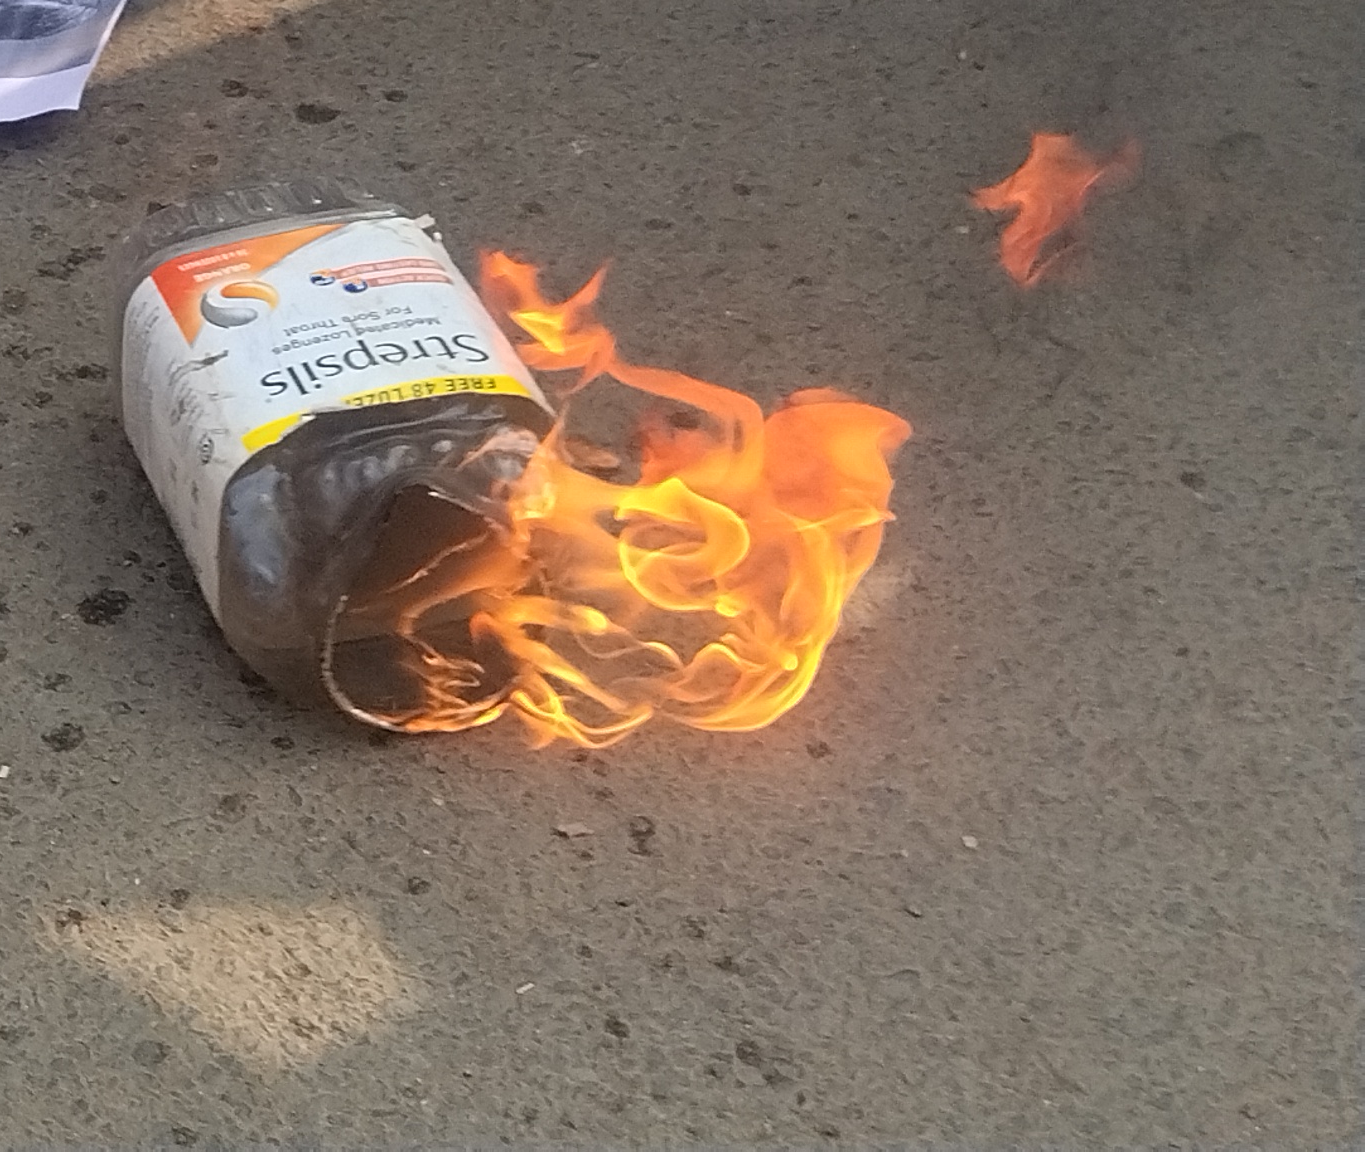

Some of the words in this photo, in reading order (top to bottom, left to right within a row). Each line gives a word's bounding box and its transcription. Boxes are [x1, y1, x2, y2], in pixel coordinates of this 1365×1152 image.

[192, 262, 251, 283] ORANGE
[341, 310, 380, 326] Sore
[385, 304, 412, 318] For
[282, 318, 338, 337] Throat
[354, 316, 441, 337] Medicated
[271, 330, 352, 355] Lozenges
[260, 333, 490, 398] Strepsils
[411, 381, 437, 398] 48
[444, 377, 497, 392] FREE
